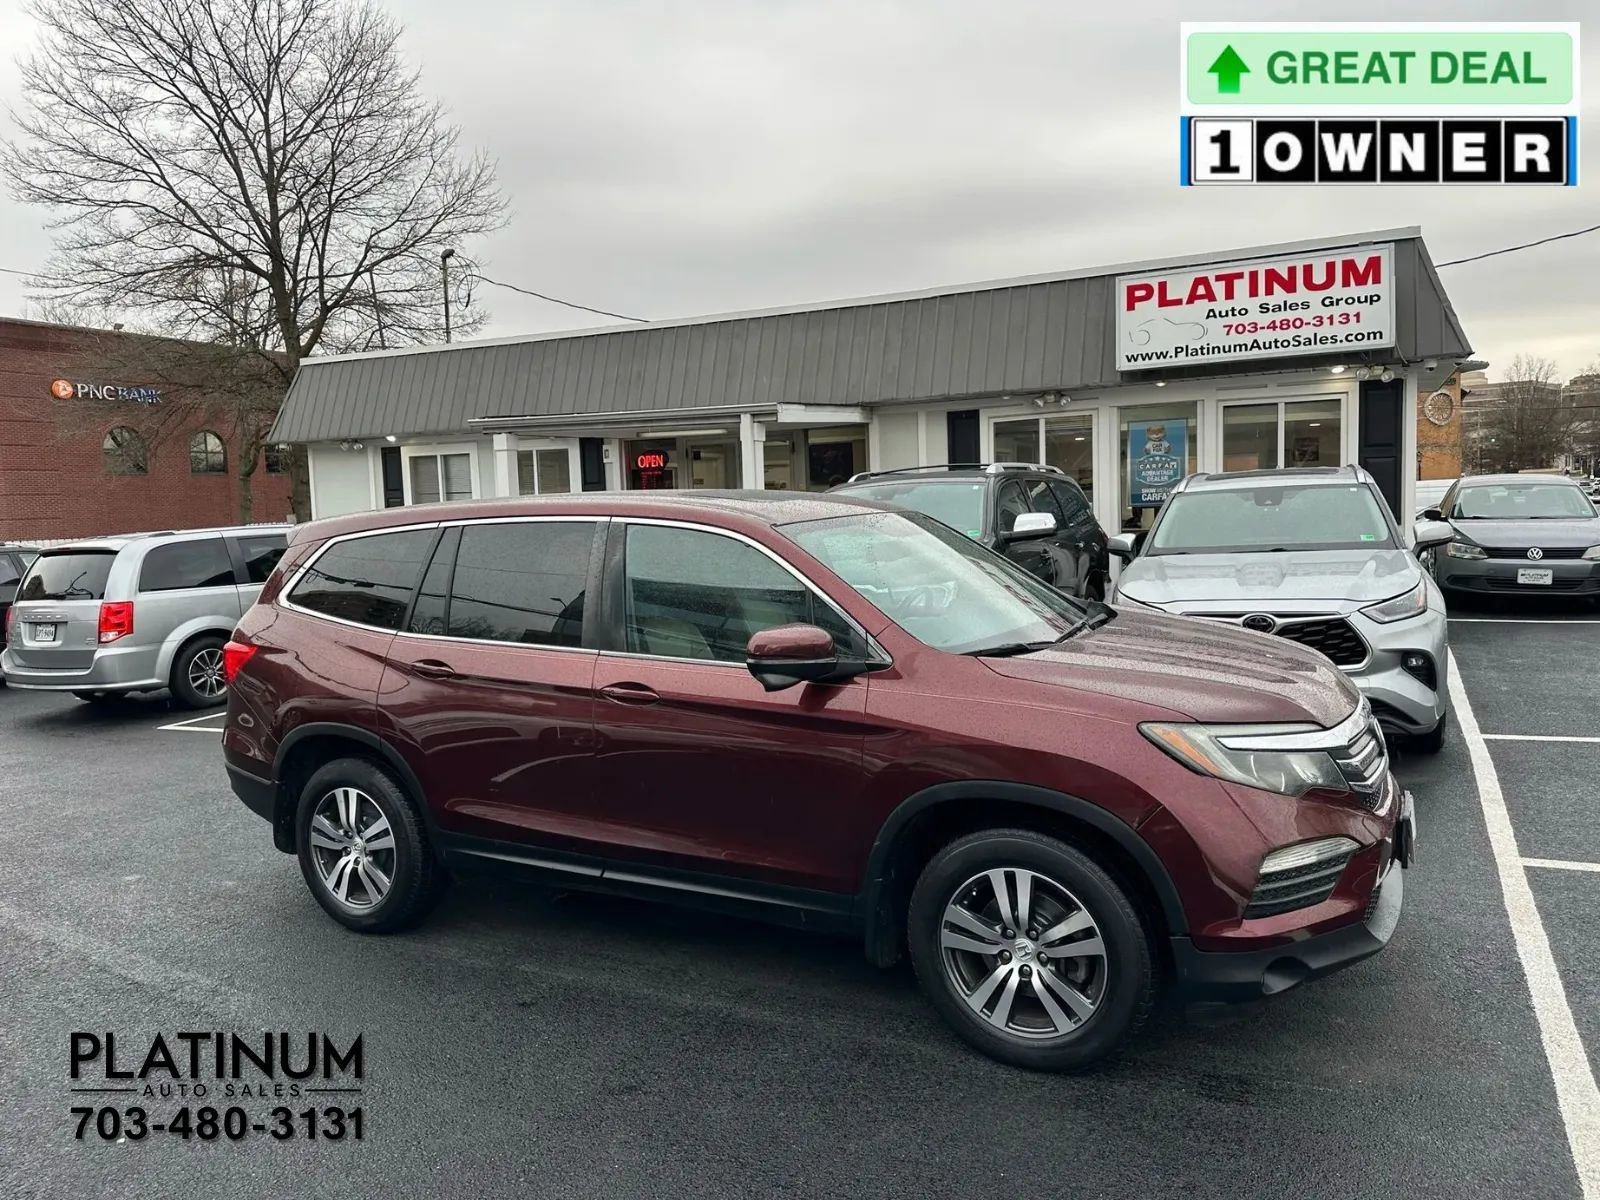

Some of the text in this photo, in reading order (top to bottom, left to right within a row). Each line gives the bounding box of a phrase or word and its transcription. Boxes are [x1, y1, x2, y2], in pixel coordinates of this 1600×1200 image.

[1126, 255, 1382, 312] PLATINUM
[1205, 292, 1381, 320] Auto Sales Group
[1223, 312, 1362, 336] 703-480-3131
[1125, 330, 1383, 363] www.PlatinumAutoSales.com
[637, 454, 664, 468] OPEN
[1139, 462, 1177, 470] CARFAX
